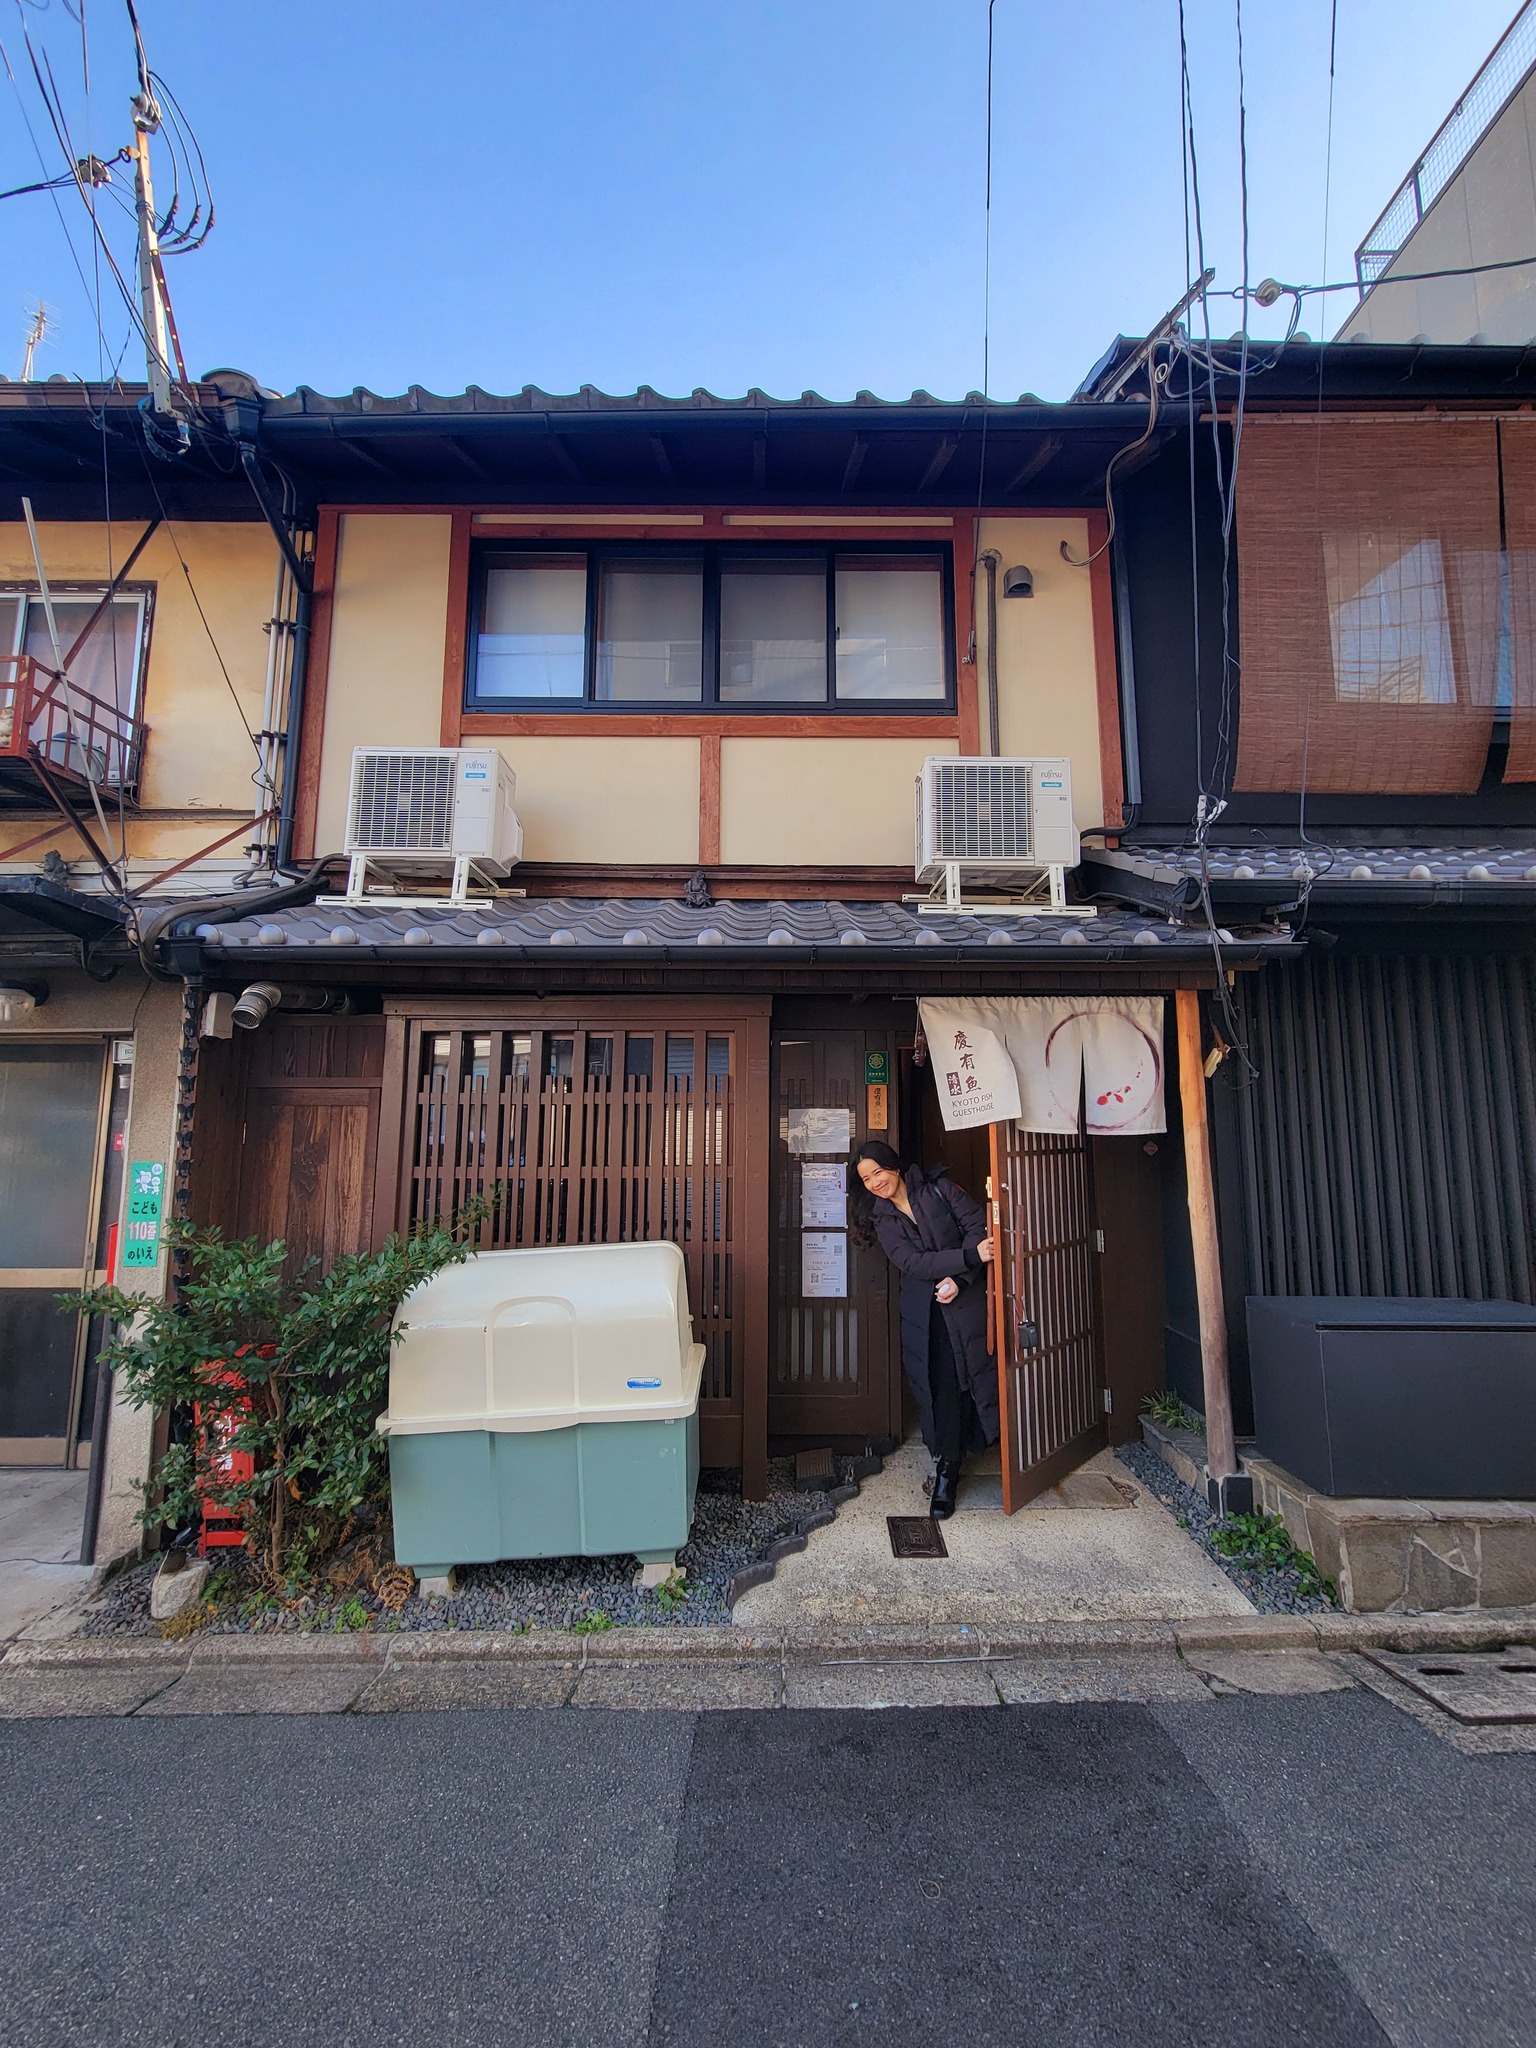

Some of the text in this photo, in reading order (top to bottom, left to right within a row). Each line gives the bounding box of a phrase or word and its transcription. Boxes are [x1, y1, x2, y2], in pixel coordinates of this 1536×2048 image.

[465, 760, 488, 770] FUJITSU
[1040, 769, 1063, 779] FUJITSU
[948, 1074, 961, 1095] 清水
[951, 1093, 993, 1108] KYOTO FISH
[952, 1102, 995, 1118] GUESTHOUSE
[131, 1201, 158, 1215] こども
[128, 1221, 157, 1240] 110番
[127, 1246, 153, 1260] のいえ
